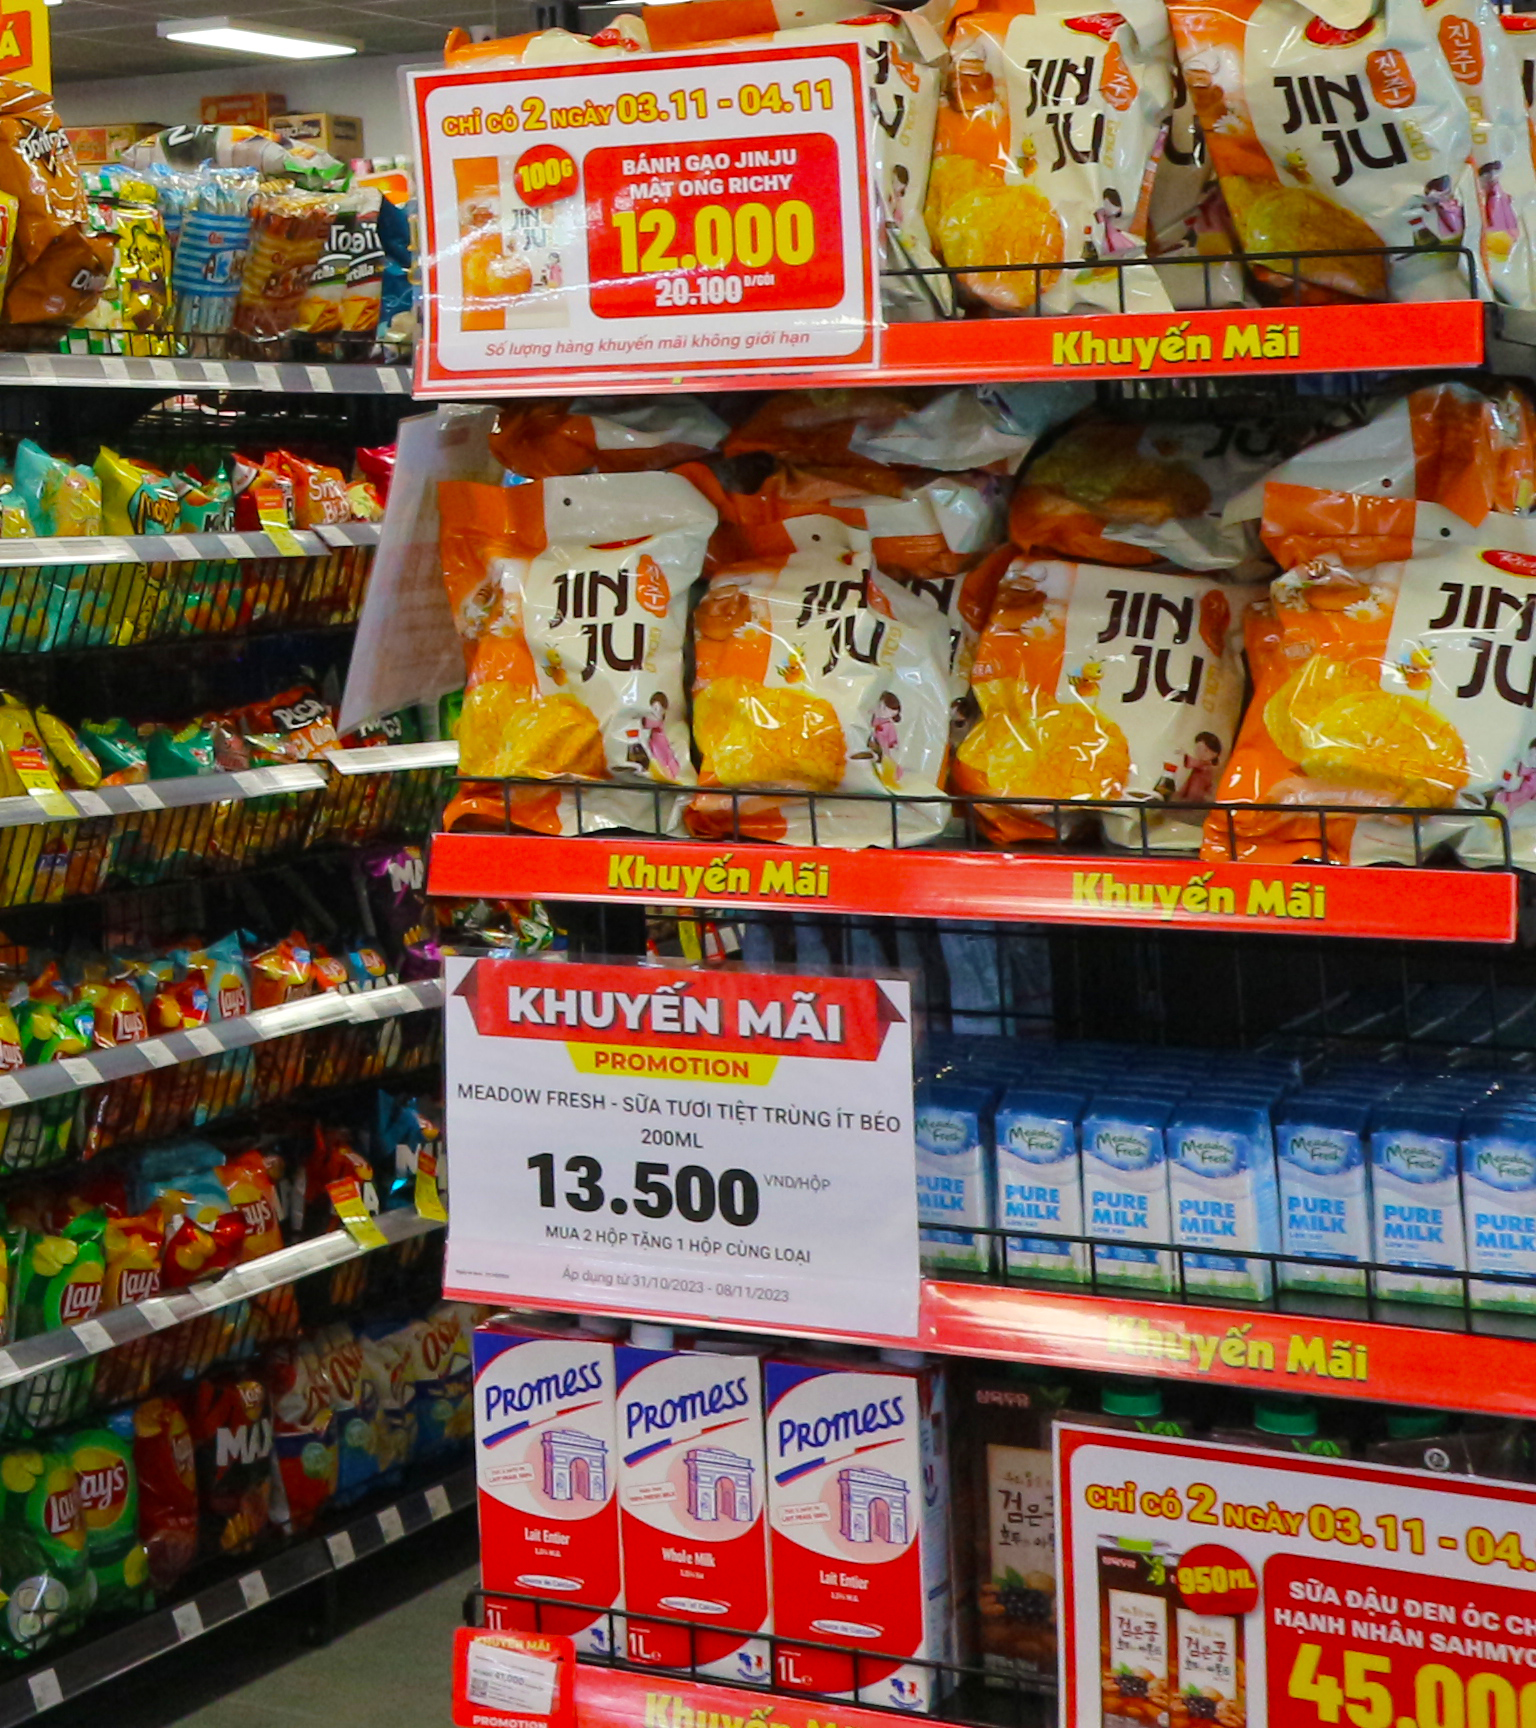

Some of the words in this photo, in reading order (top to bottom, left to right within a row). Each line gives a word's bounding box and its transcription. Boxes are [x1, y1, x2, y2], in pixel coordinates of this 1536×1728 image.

[443, 107, 480, 136] CHỈ
[486, 101, 519, 133] CÓ
[522, 98, 546, 130] 2
[551, 101, 613, 129] NGÀY
[617, 89, 707, 124] 03.11
[739, 79, 833, 117] 04.11
[1274, 75, 1369, 134] JIN
[518, 158, 573, 194] 100G
[622, 153, 680, 176] BÁNH
[685, 152, 730, 175] GẠO
[735, 148, 797, 168] JINJU
[1322, 123, 1407, 186] JU
[631, 177, 673, 201] MẬT
[680, 178, 724, 197] ONG
[729, 174, 793, 193] RICHY
[613, 200, 814, 274] 12.000
[656, 276, 742, 306] 20.100
[485, 337, 505, 357] Số
[510, 337, 551, 360] lượng
[556, 336, 593, 357] hàng
[598, 333, 654, 354] khuyến
[658, 335, 687, 350] mãi
[692, 331, 742, 350] không
[746, 331, 775, 348] giới
[780, 331, 809, 346] hạn
[1053, 321, 1211, 370] Khuyến
[1222, 323, 1300, 358] Mãi
[1097, 589, 1193, 644] JIN
[1122, 645, 1204, 705] JU
[607, 853, 749, 898] Khuyến
[760, 860, 829, 898] Mãi
[507, 981, 722, 1036] KHUYẾN
[738, 992, 842, 1042] MÃI
[594, 1051, 749, 1078] PROMOTION
[457, 1083, 541, 1104] MEADOW
[546, 1091, 605, 1110] FRESH
[622, 1094, 661, 1116] SỮA
[666, 1099, 710, 1119] TƯƠI
[717, 1100, 759, 1123] TIỆT
[765, 1104, 830, 1128] TRÙNG
[836, 1106, 854, 1128] ÍT
[860, 1111, 901, 1133] BÉO
[641, 1128, 704, 1149] 200ML
[528, 1153, 760, 1227] 13.500
[1288, 1196, 1345, 1215] PURE
[545, 1225, 580, 1241] MUA
[583, 1229, 592, 1242] 2
[596, 1228, 627, 1247] HỘP
[632, 1230, 672, 1250] TẶNG
[678, 1239, 683, 1250] 1
[690, 1237, 722, 1257] HỘP
[726, 1240, 770, 1260] CÙNG
[776, 1247, 810, 1266] LOẠI
[1288, 1214, 1347, 1234] MILK
[628, 1376, 749, 1439] Promess
[1086, 1481, 1135, 1514] CHỈ
[1141, 1490, 1181, 1520] CÓ
[1187, 1483, 1217, 1525] 2
[1223, 1502, 1303, 1536] NGÀY
[1308, 1505, 1424, 1553] 03.11
[662, 1548, 690, 1564] Whole
[840, 1572, 869, 1590] Entier
[1178, 1566, 1257, 1594] 950ML
[1289, 1577, 1340, 1607] SỮA
[1345, 1585, 1397, 1616] ĐẬU
[1403, 1598, 1456, 1625] ĐEN
[1464, 1601, 1499, 1631] ÓC
[1275, 1608, 1345, 1637] HẠNH
[1351, 1621, 1423, 1649] NHÂN
